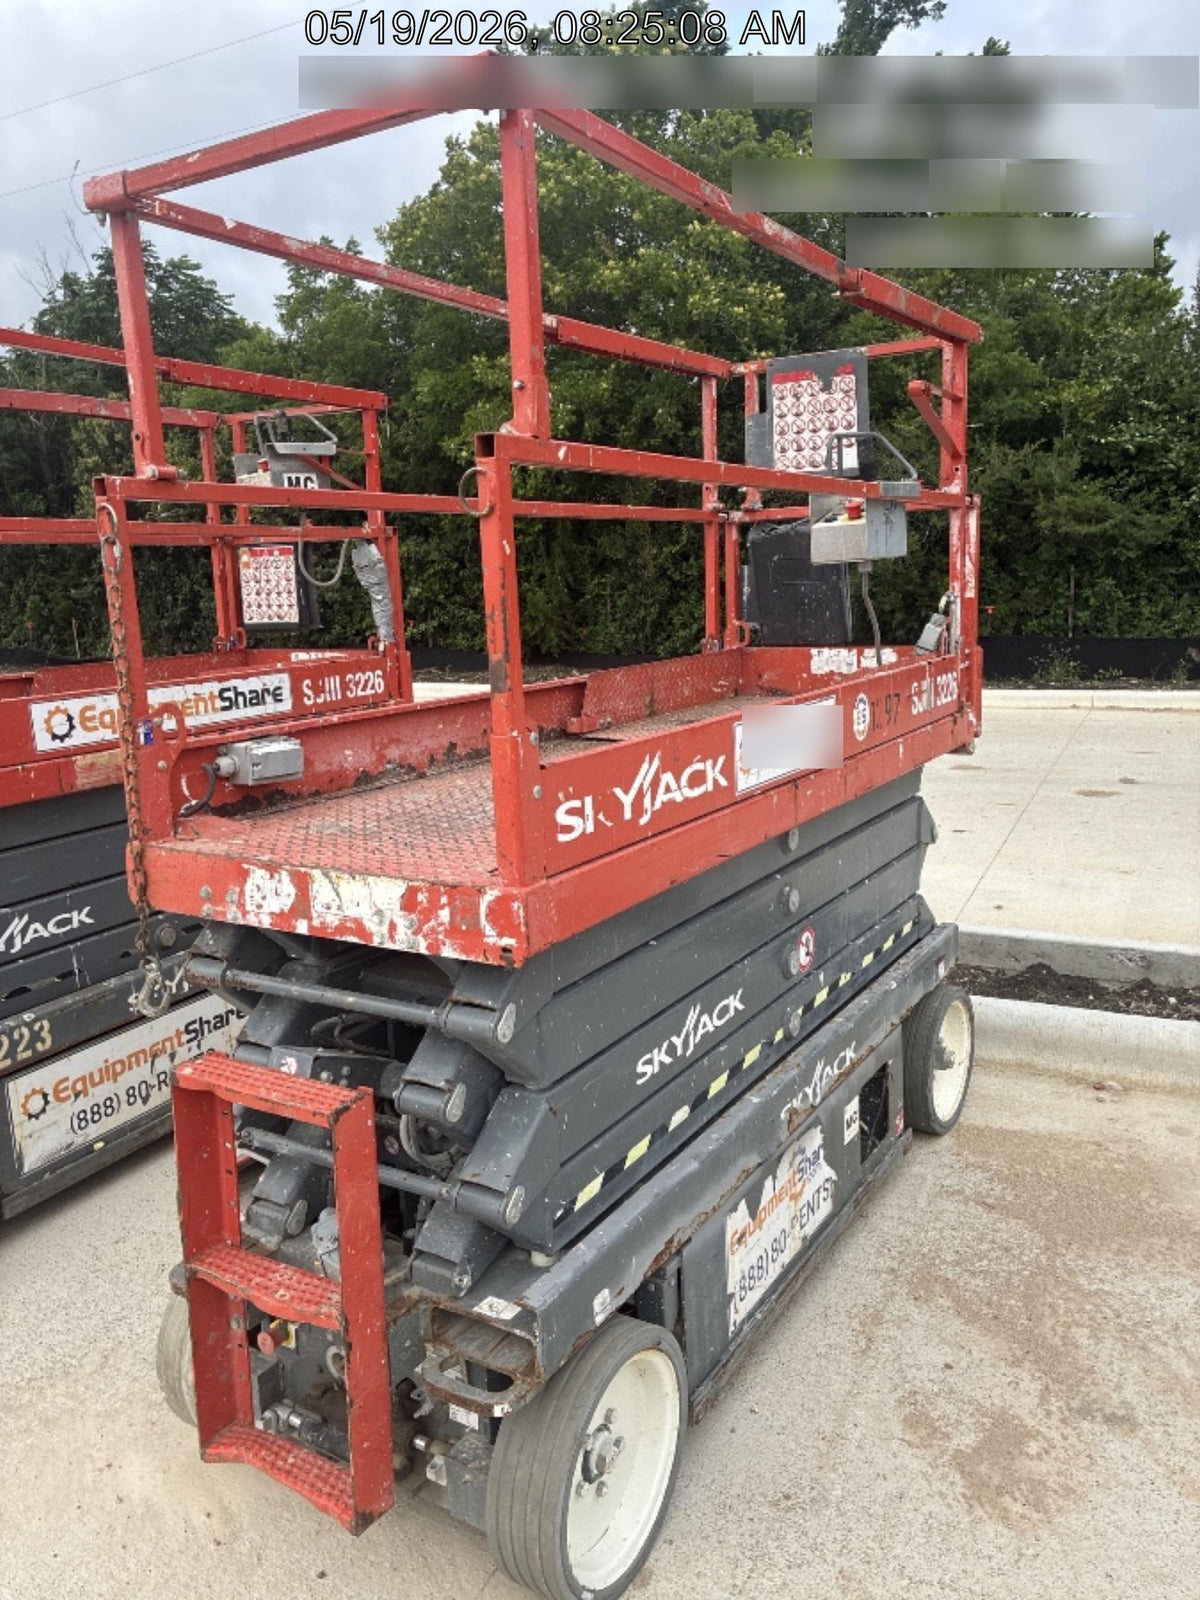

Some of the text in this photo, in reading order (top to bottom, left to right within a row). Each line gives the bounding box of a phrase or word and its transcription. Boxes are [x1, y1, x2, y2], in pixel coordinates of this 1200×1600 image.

[287, 475, 316, 490] MC
[346, 670, 384, 698] 3226
[636, 988, 745, 1085] SKYJACK
[70, 1092, 121, 1135] (888)
